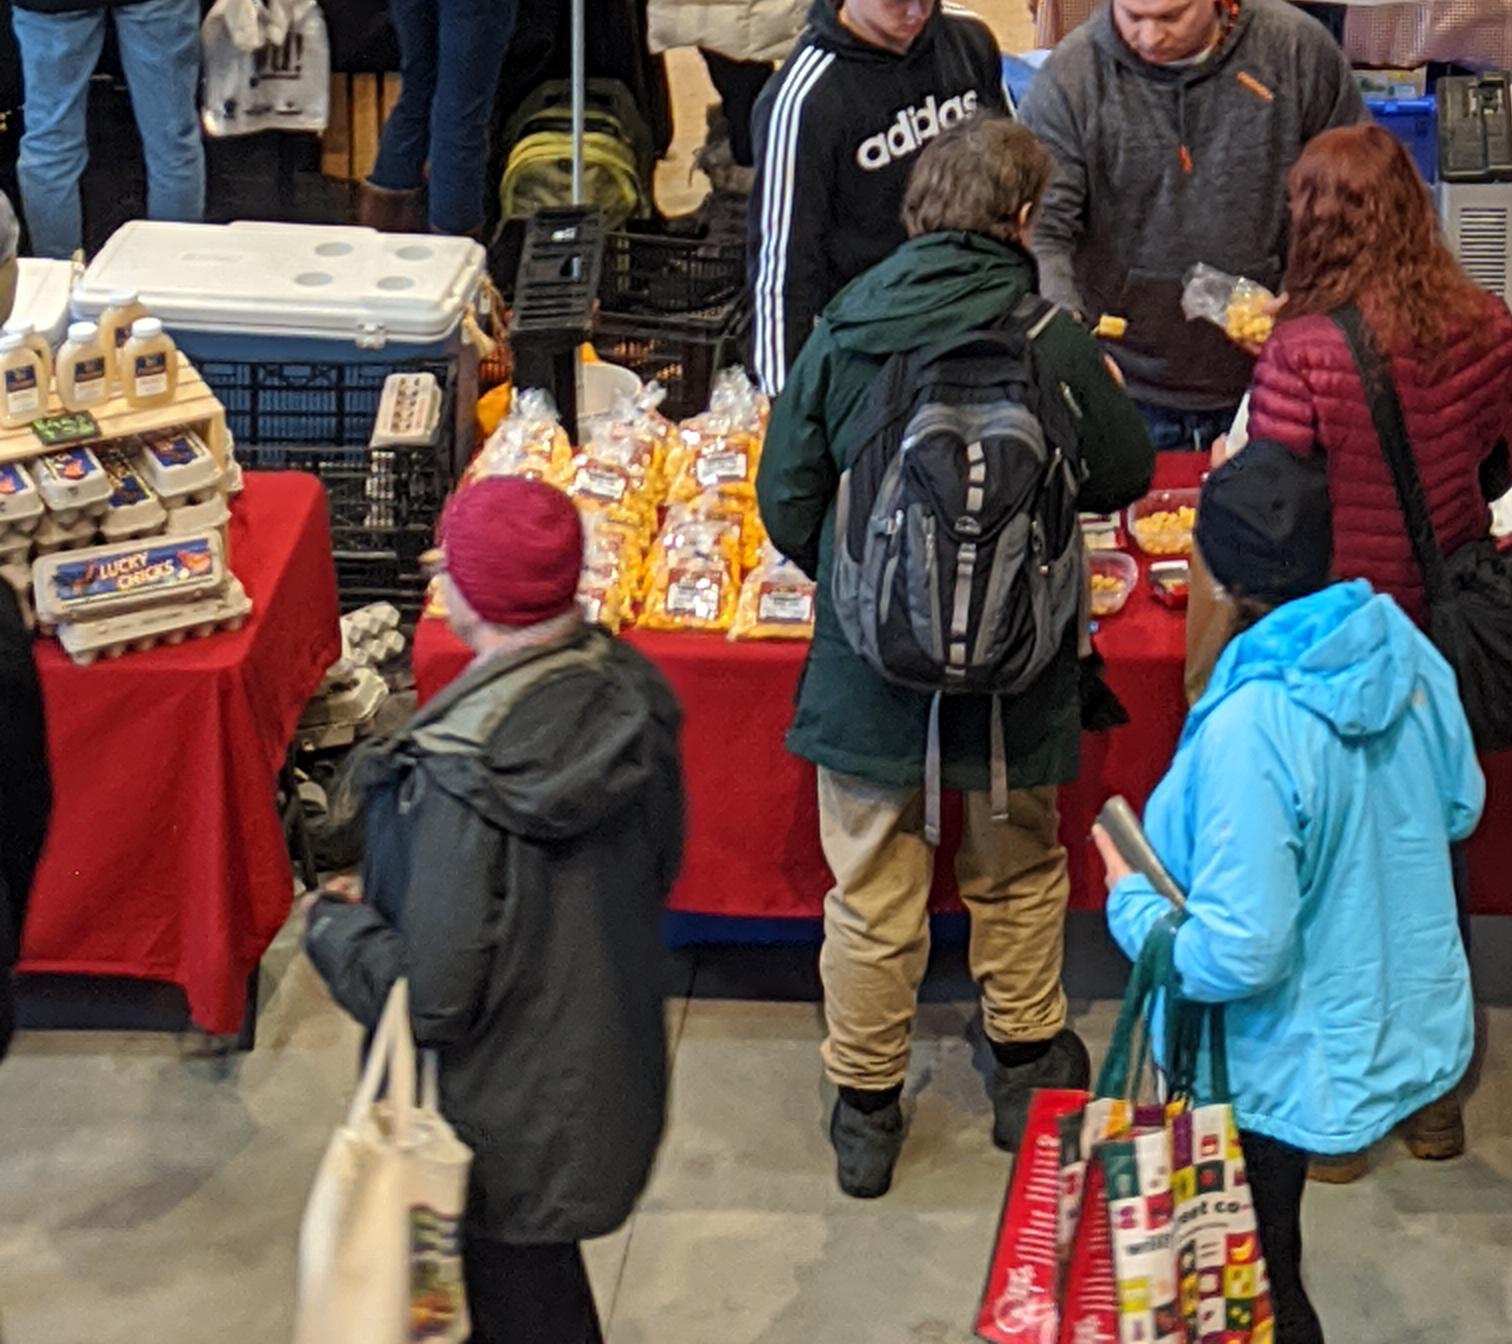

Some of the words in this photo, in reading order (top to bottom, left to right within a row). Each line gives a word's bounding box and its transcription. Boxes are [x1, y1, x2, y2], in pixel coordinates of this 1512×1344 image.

[857, 89, 978, 170] adidas
[100, 551, 149, 580] LUCKY
[116, 559, 176, 590] CHICKS
